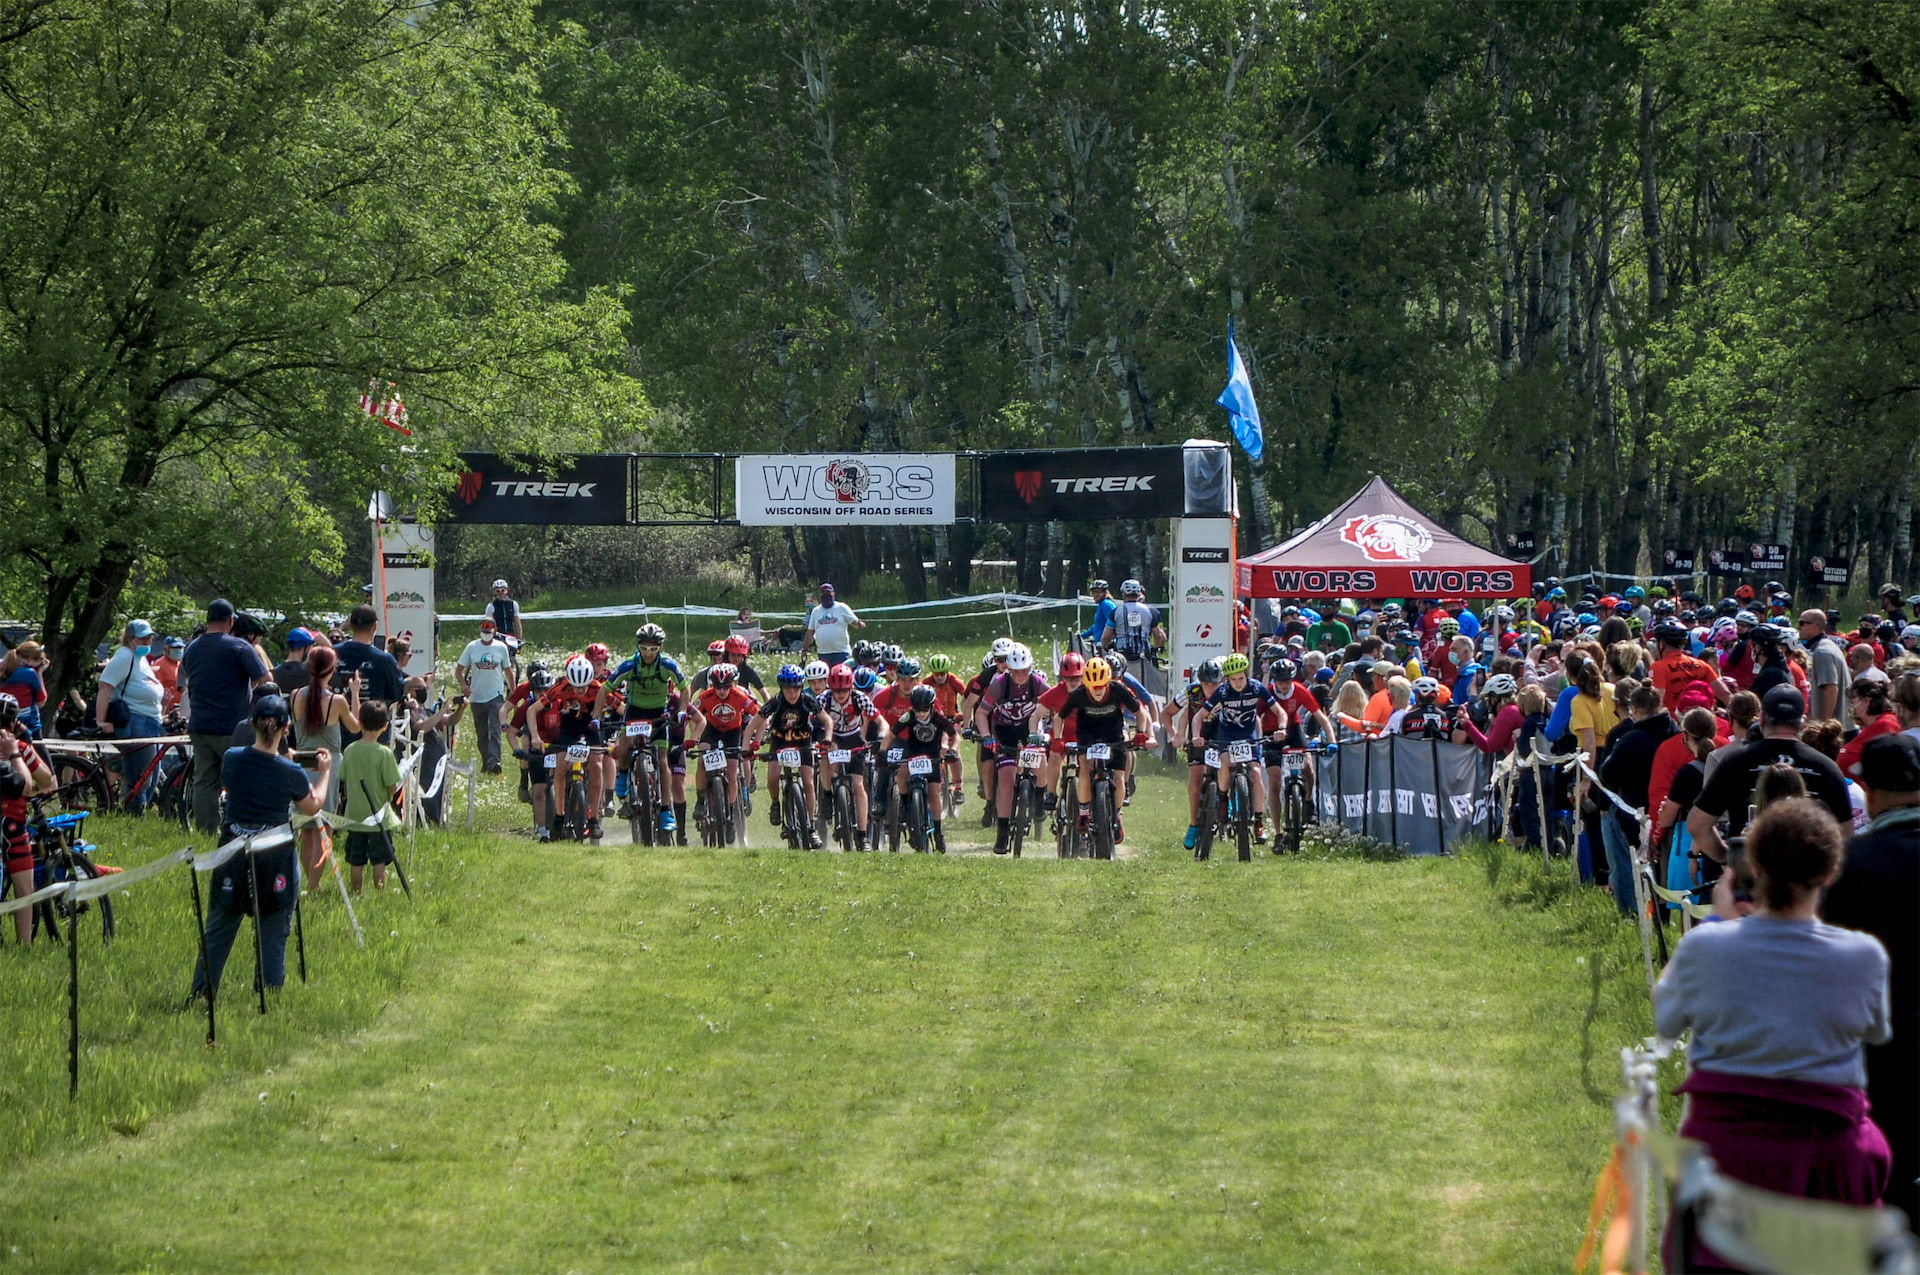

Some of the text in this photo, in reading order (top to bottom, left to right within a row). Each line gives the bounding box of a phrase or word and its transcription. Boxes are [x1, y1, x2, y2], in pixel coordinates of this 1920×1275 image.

[491, 481, 598, 498] TREK
[1050, 475, 1156, 493] TREK
[765, 507, 933, 515] WISCONSIN OFF ROAD SERIES
[1273, 570, 1376, 592] WORS
[1410, 570, 1514, 593] WORS
[1230, 744, 1250, 756] 4243
[705, 752, 723, 765] 4231
[779, 751, 799, 762] 4013
[1021, 752, 1040, 763] 4031
[910, 759, 930, 769] 4001
